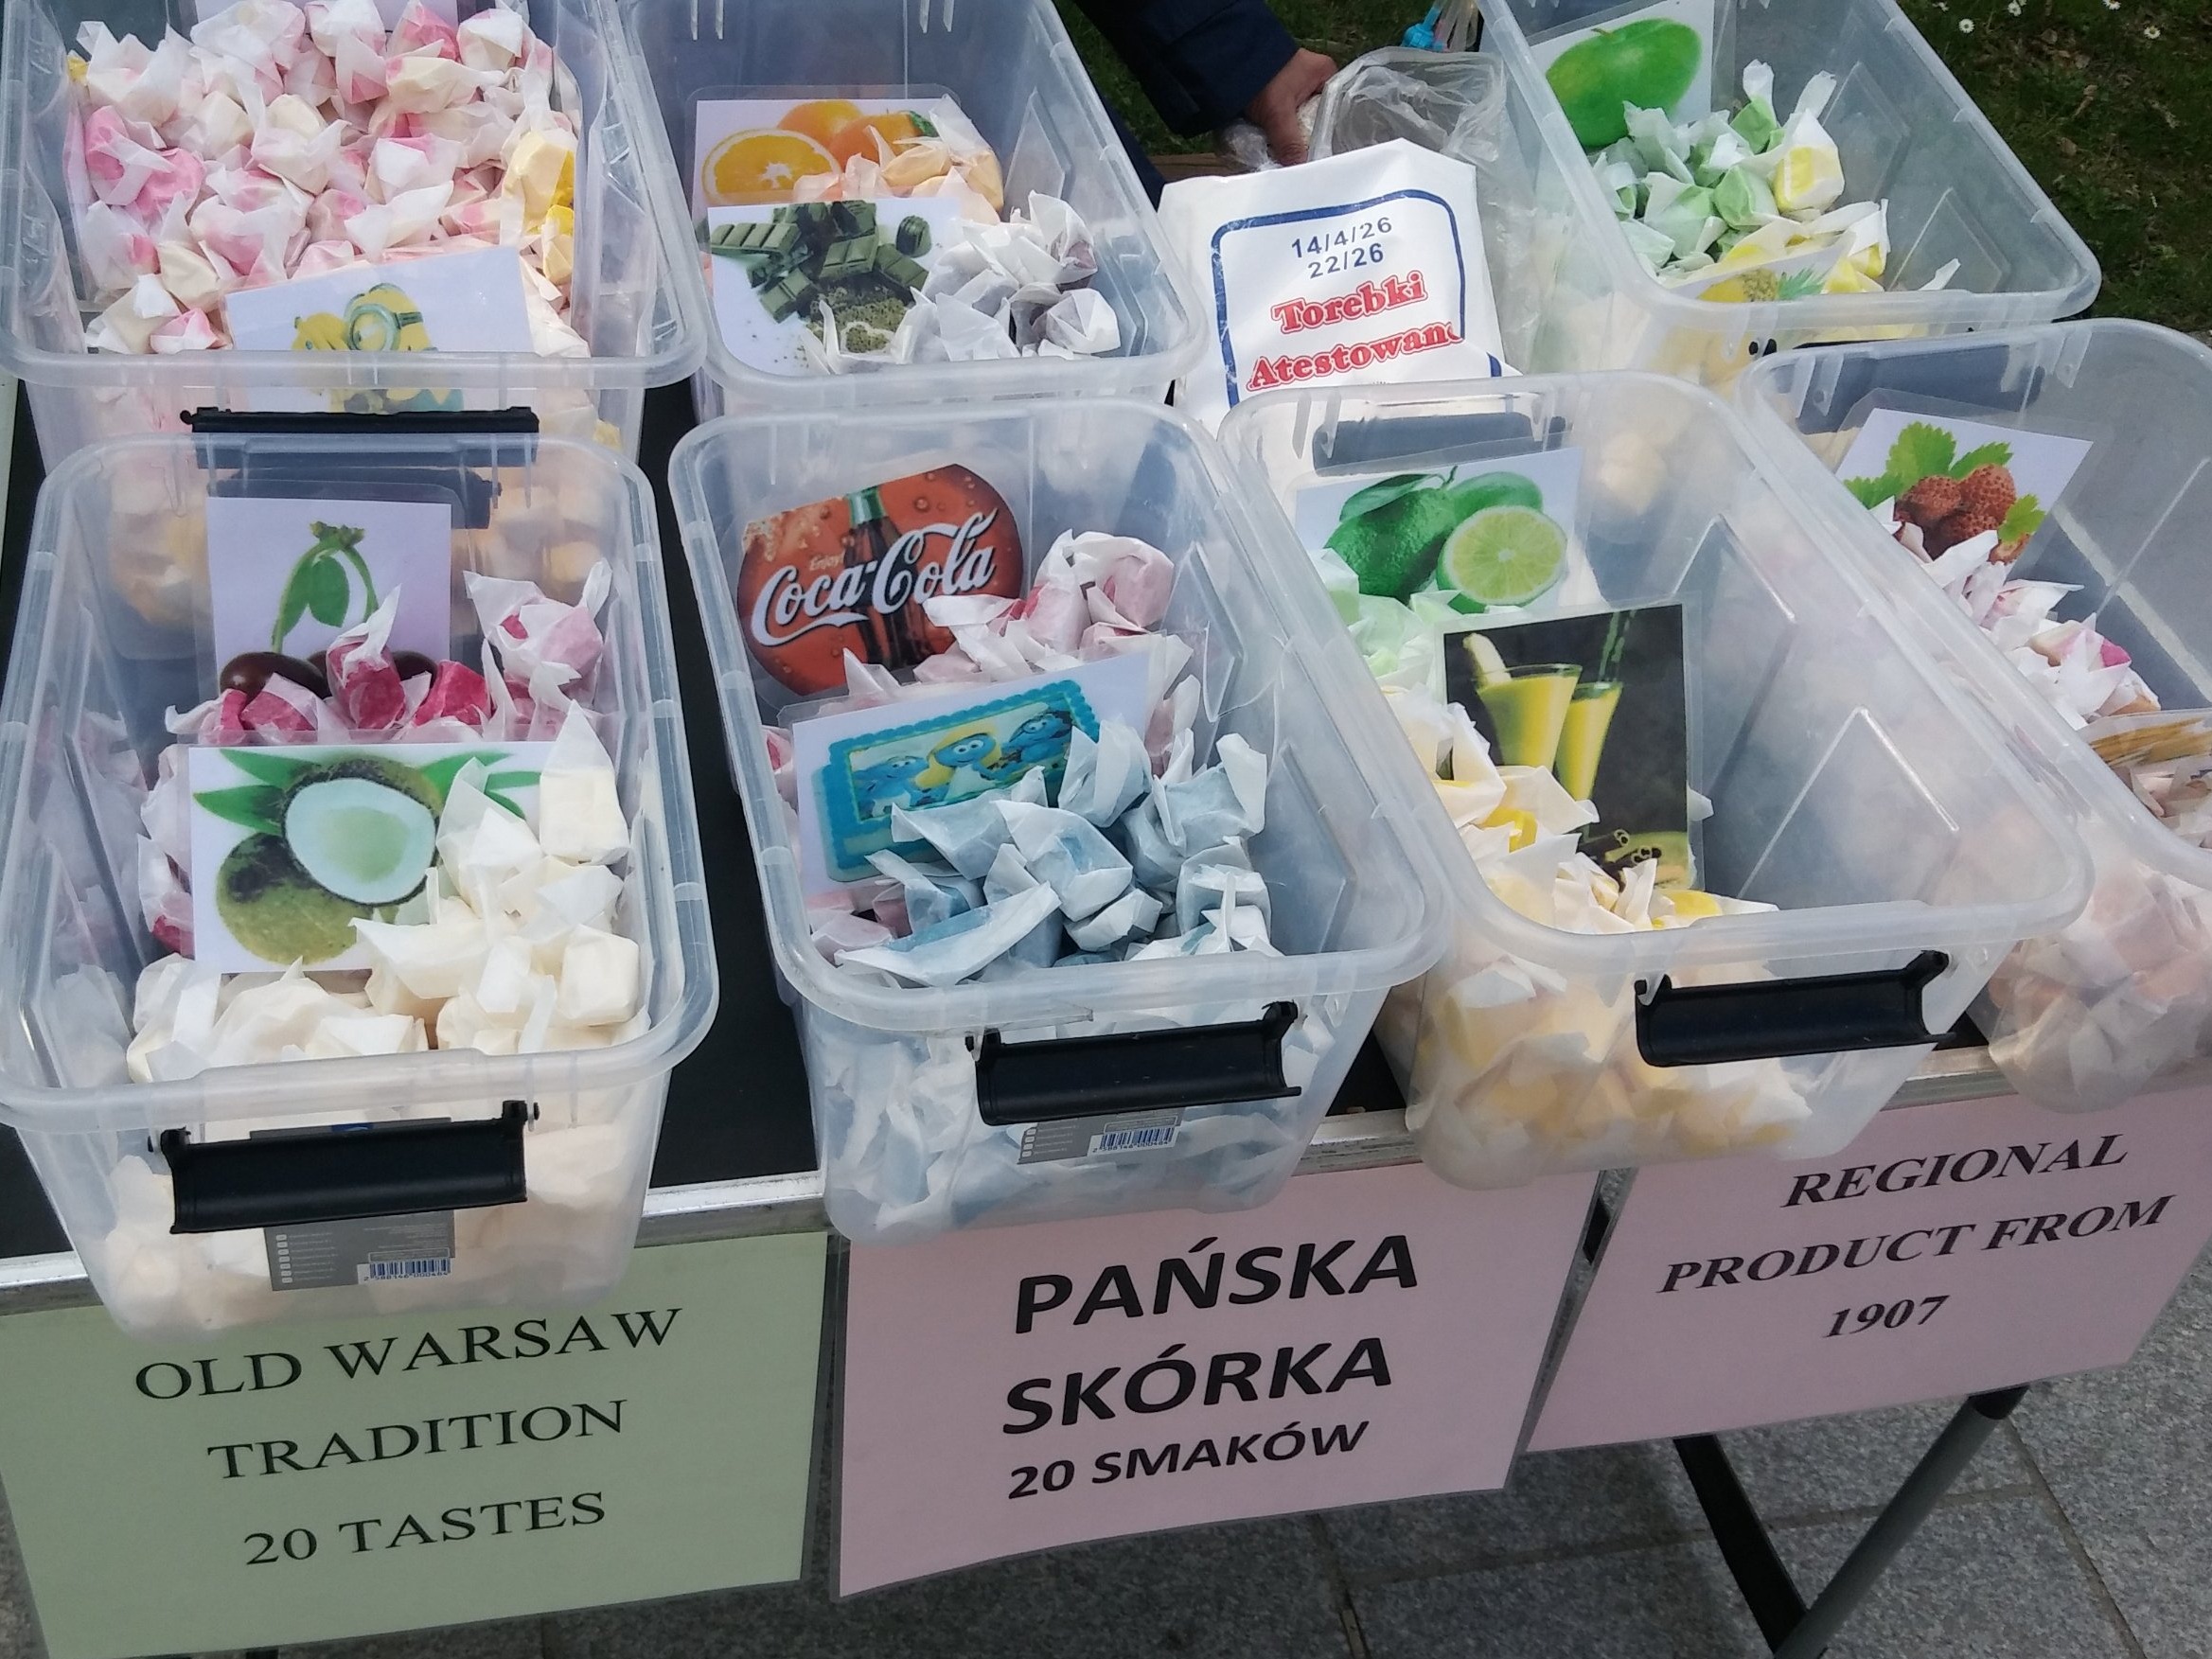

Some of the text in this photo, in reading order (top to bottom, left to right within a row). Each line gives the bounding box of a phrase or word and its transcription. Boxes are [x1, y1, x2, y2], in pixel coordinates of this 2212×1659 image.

[1291, 217, 1392, 258] 14/4/26
[1307, 242, 1384, 279] 22/26
[1272, 271, 1427, 332] Torebki
[751, 508, 998, 646] Coca-Cola
[1781, 1134, 2129, 1208] REGIONAL
[1655, 1194, 2176, 1294] PRODUCT FROM
[1016, 1235, 1418, 1334] PAŃSKA
[1825, 1295, 1950, 1338] 1907
[135, 1308, 683, 1400] OLD WARSAW
[1003, 1338, 1392, 1435] SKÓRKA
[206, 1399, 628, 1479] TRADITION
[1009, 1421, 1370, 1500] 20 SMAKÓW
[243, 1491, 605, 1565] 20 TASTES
